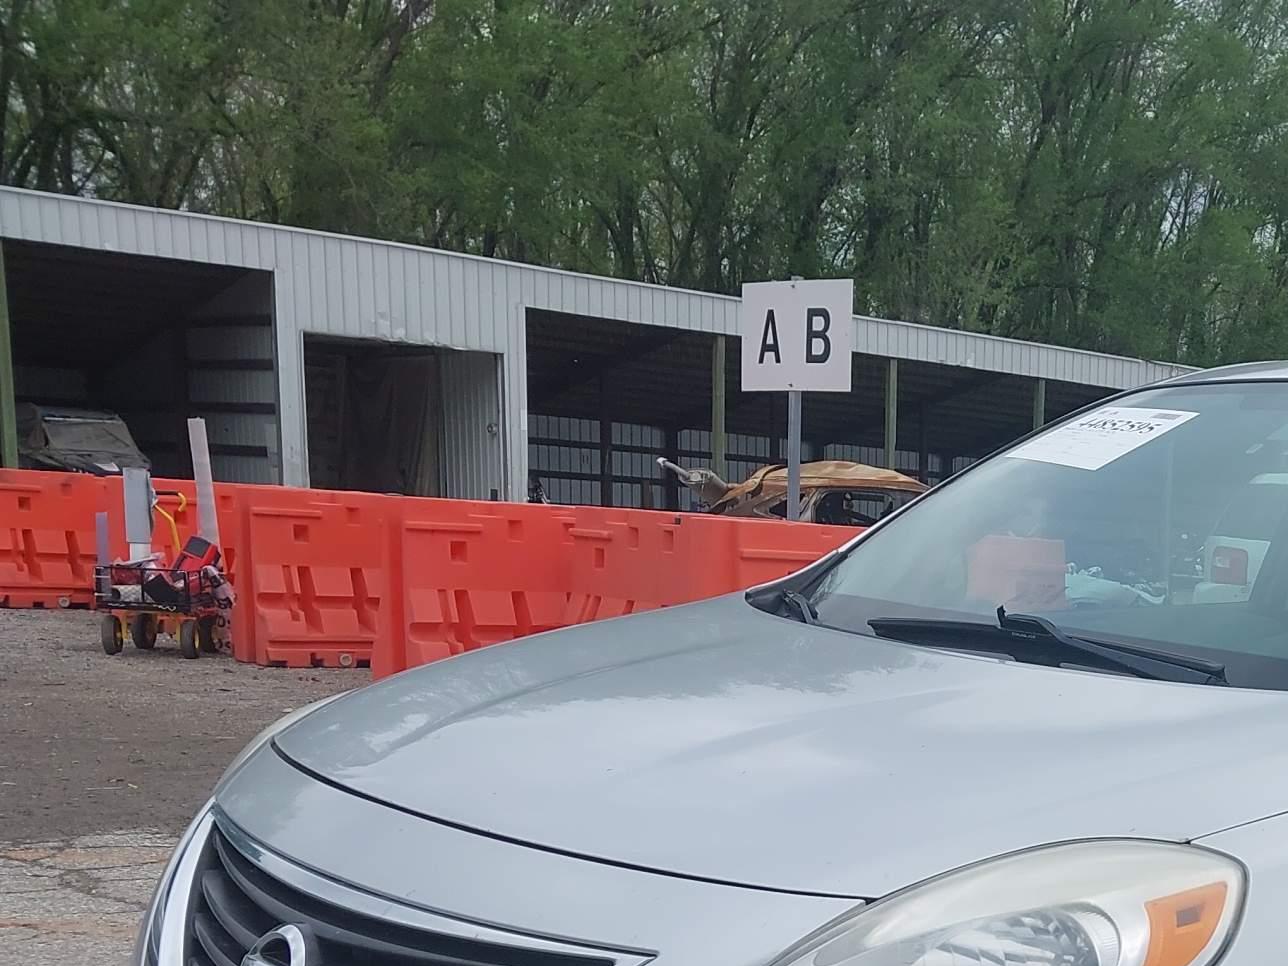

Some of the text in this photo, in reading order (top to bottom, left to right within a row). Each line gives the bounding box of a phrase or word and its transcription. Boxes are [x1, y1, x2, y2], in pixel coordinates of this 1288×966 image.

[758, 307, 832, 365] A B
[1079, 418, 1163, 434] 44852595
